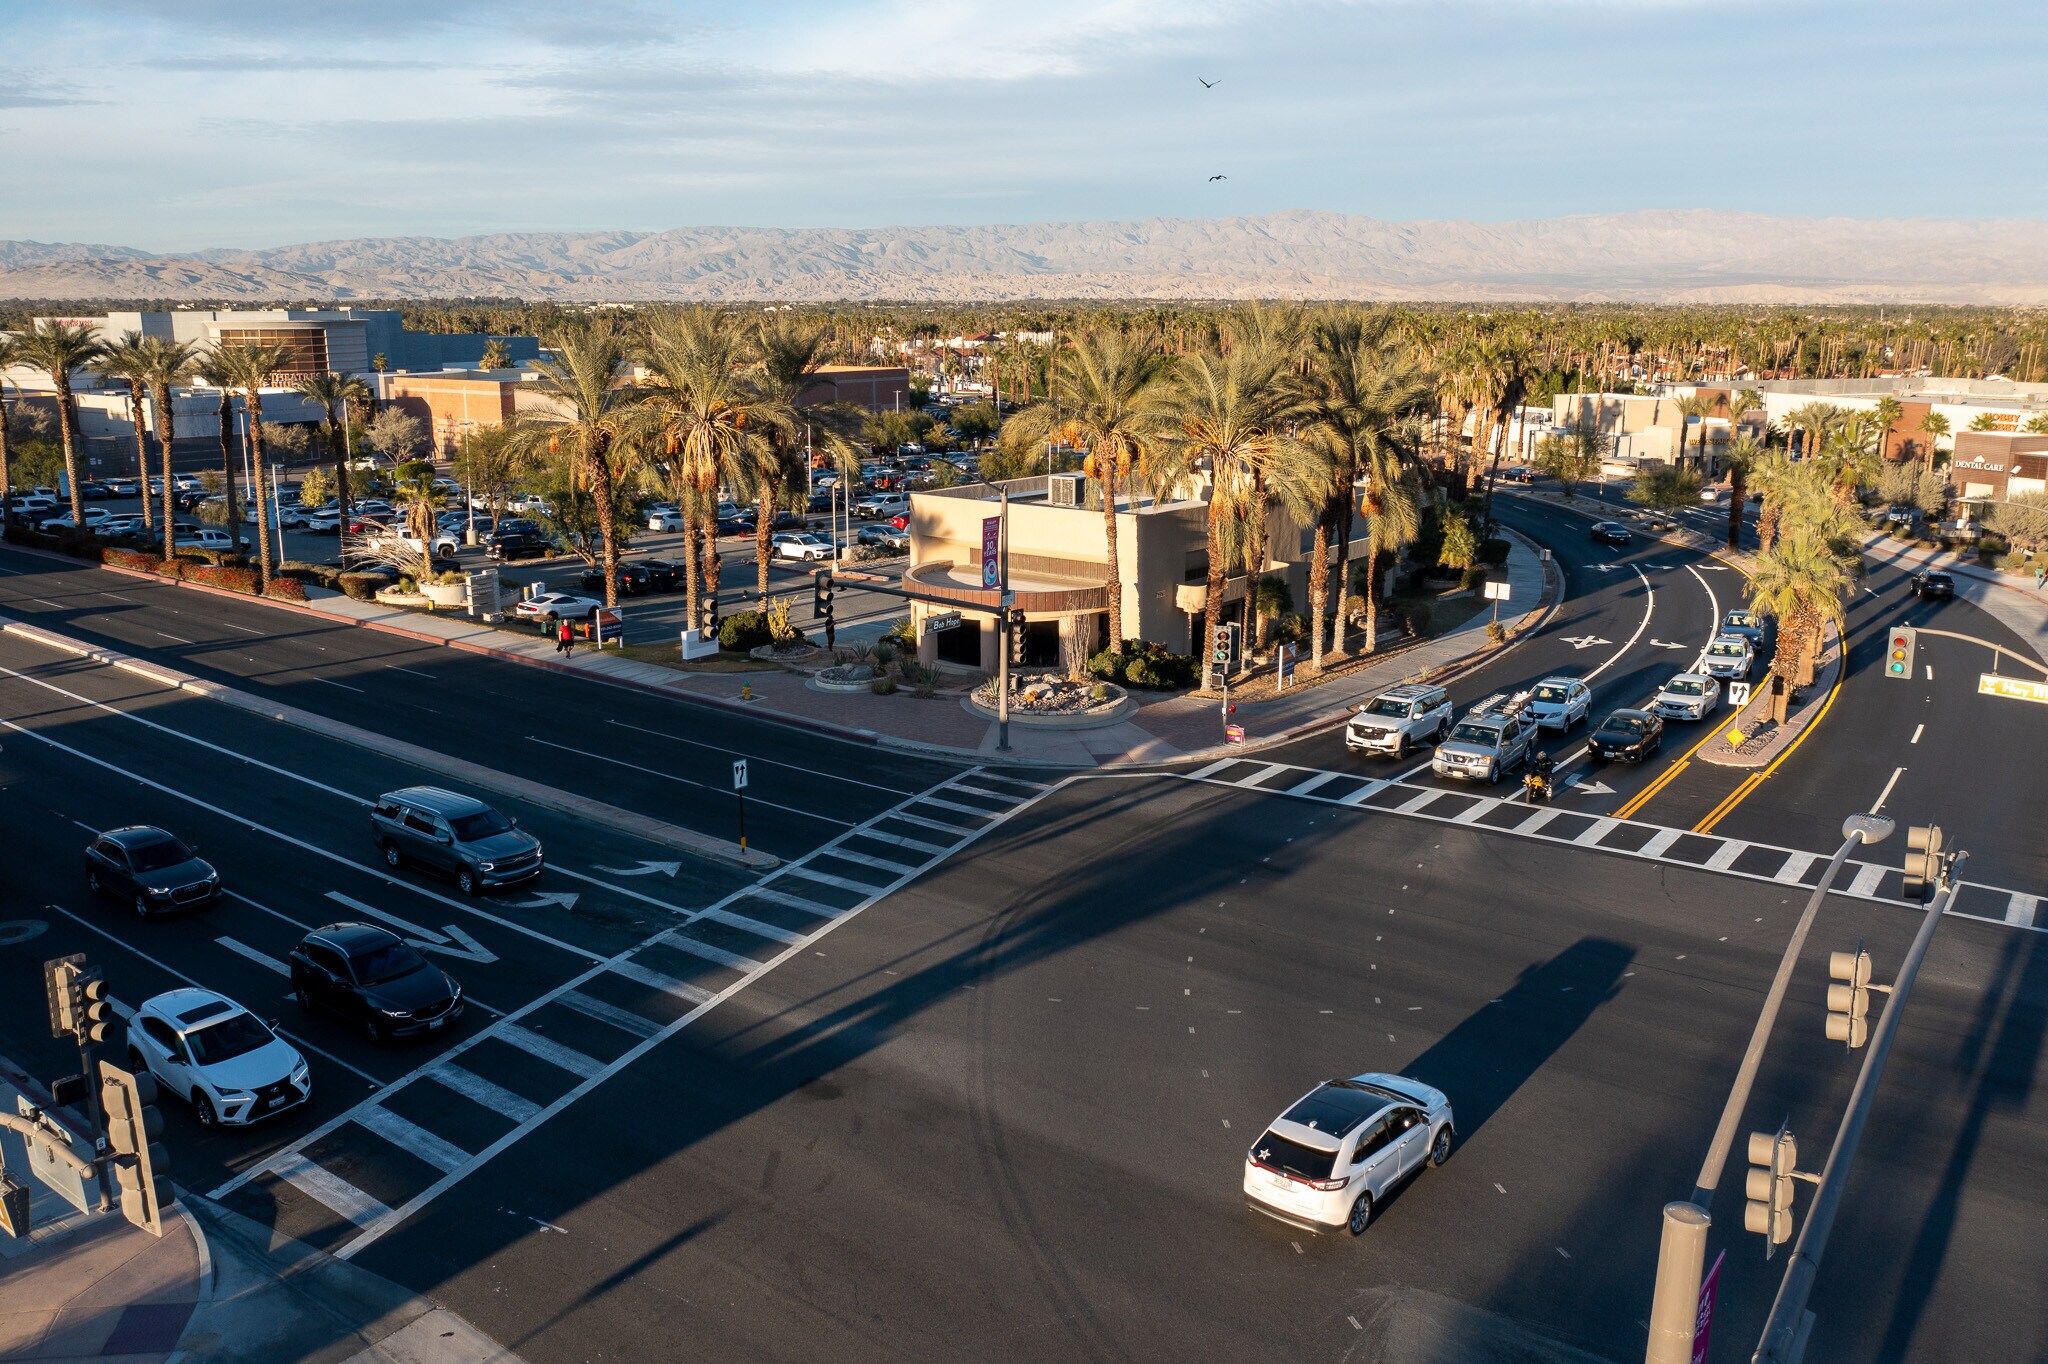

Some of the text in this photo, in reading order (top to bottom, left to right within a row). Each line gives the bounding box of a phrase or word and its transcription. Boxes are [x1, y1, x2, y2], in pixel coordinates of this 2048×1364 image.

[269, 372, 322, 383] THEATRES
[1955, 461, 2005, 472] DENTAL CARE
[986, 540, 994, 549] 10
[933, 617, 960, 630] Bob Hope
[2002, 681, 2030, 698] Hwy
